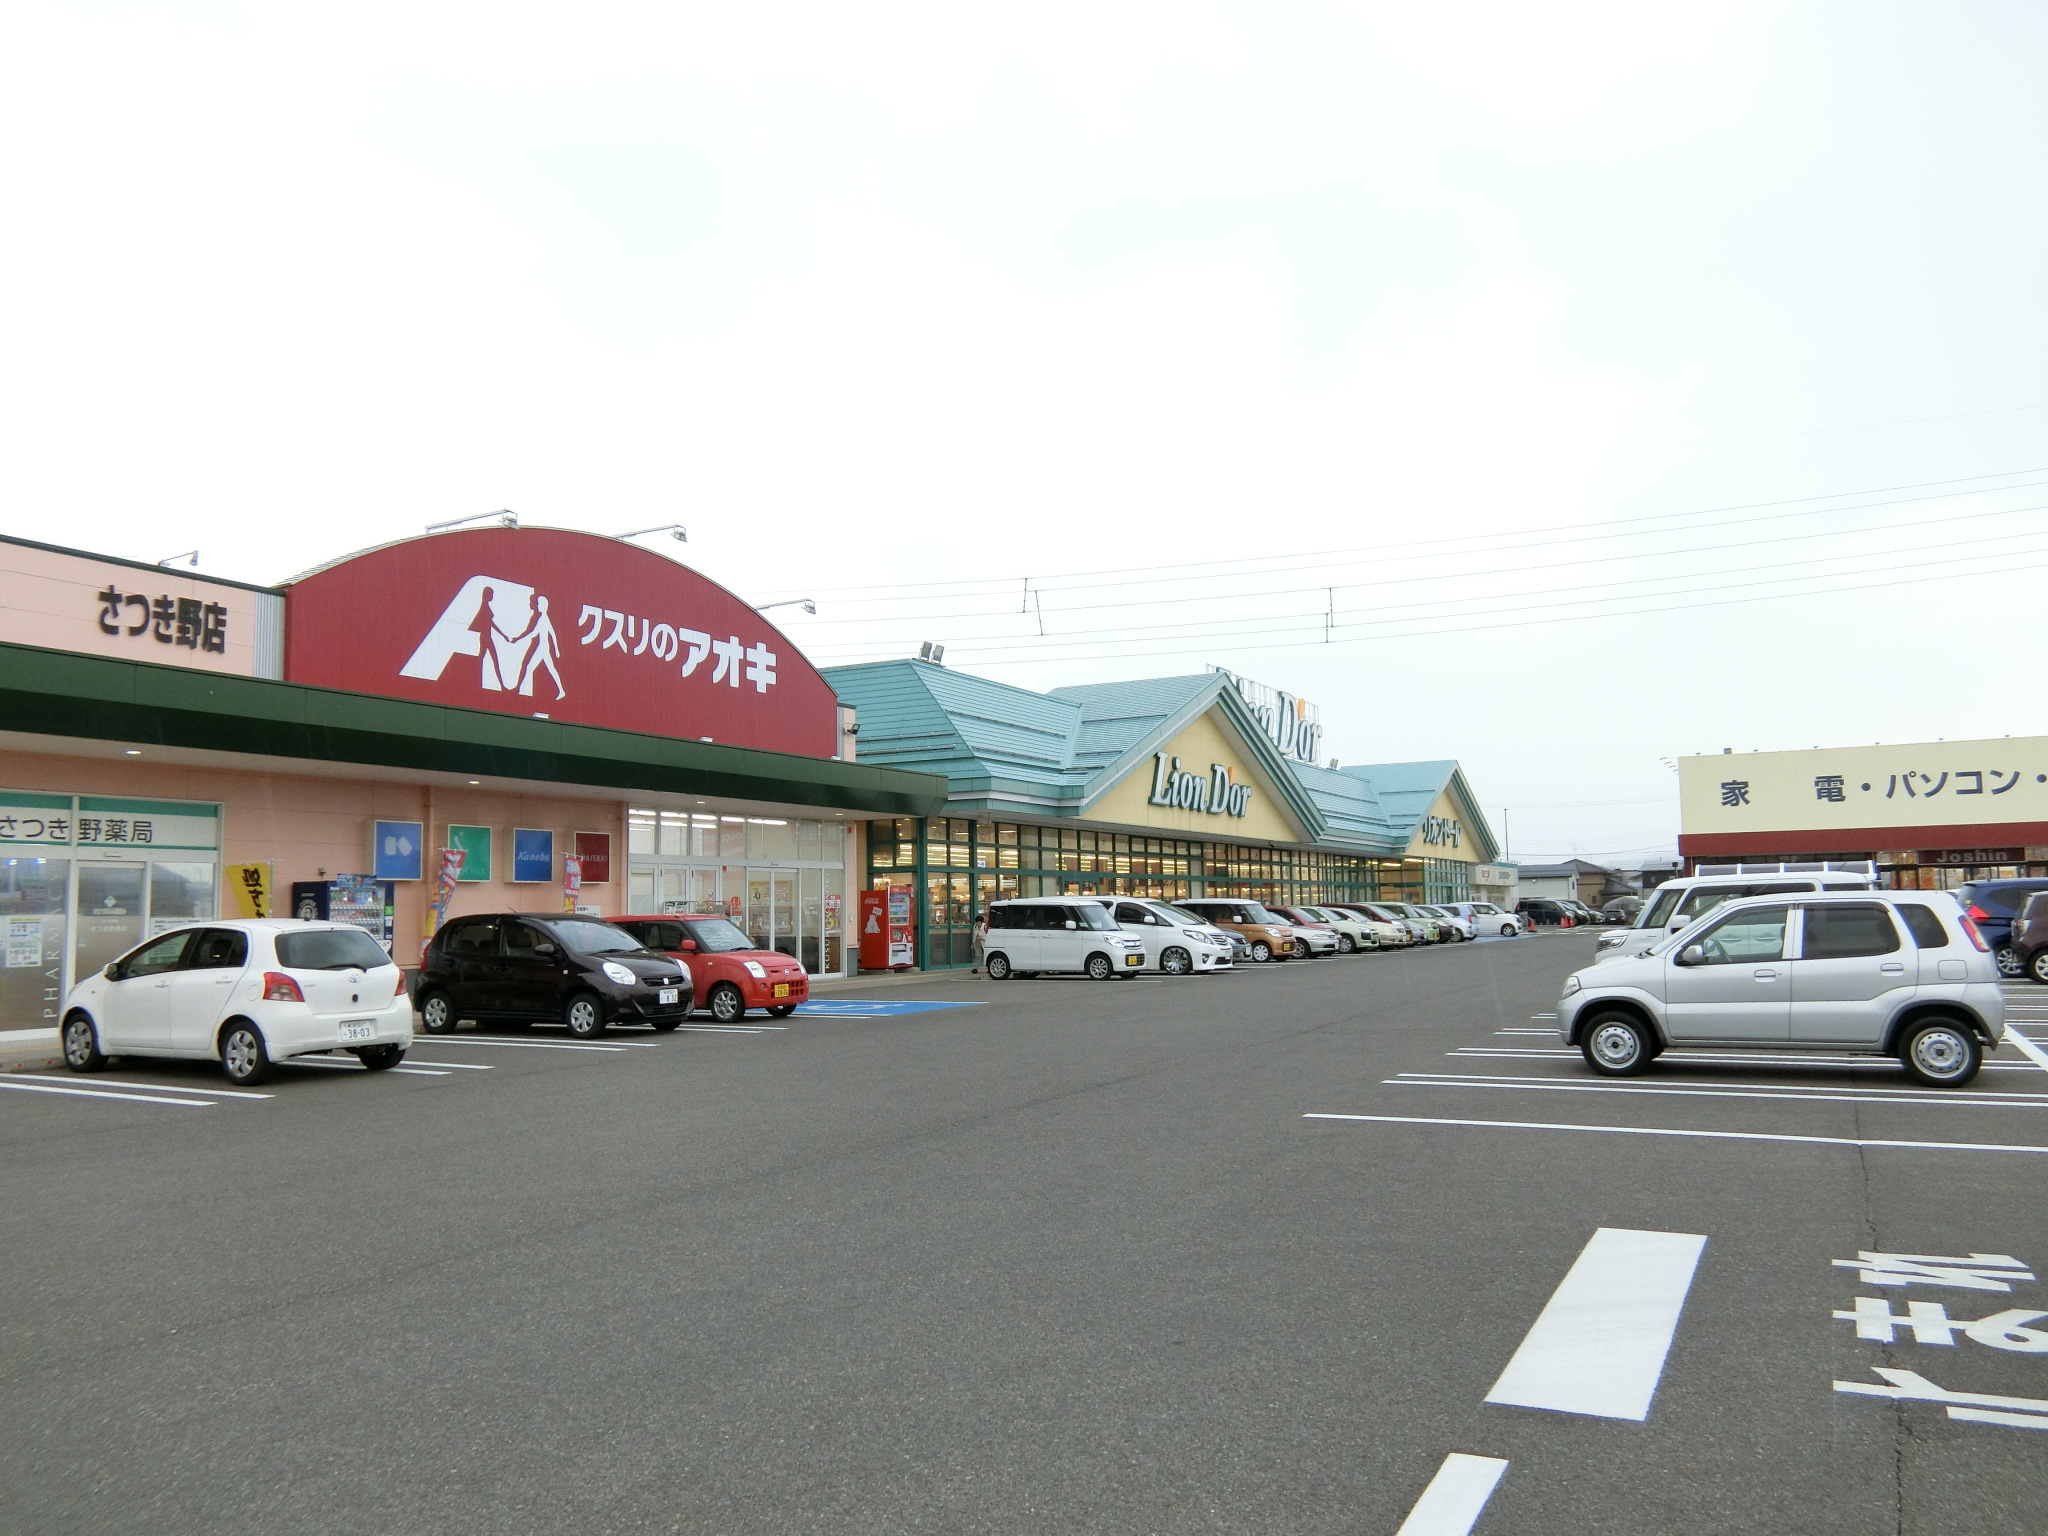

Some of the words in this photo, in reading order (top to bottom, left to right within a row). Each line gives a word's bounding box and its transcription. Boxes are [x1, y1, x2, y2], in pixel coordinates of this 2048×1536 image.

[98, 584, 227, 654] さつき野店
[578, 603, 778, 694] クスリのアオキ
[1149, 751, 1208, 812] Lion
[1207, 762, 1253, 817] D'or
[0, 815, 153, 843] さつき野薬局
[517, 851, 550, 862] Kanebo
[1936, 849, 2008, 864] Joshin
[43, 871, 65, 1019] PHARMACY
[347, 1027, 370, 1039] 38-03
